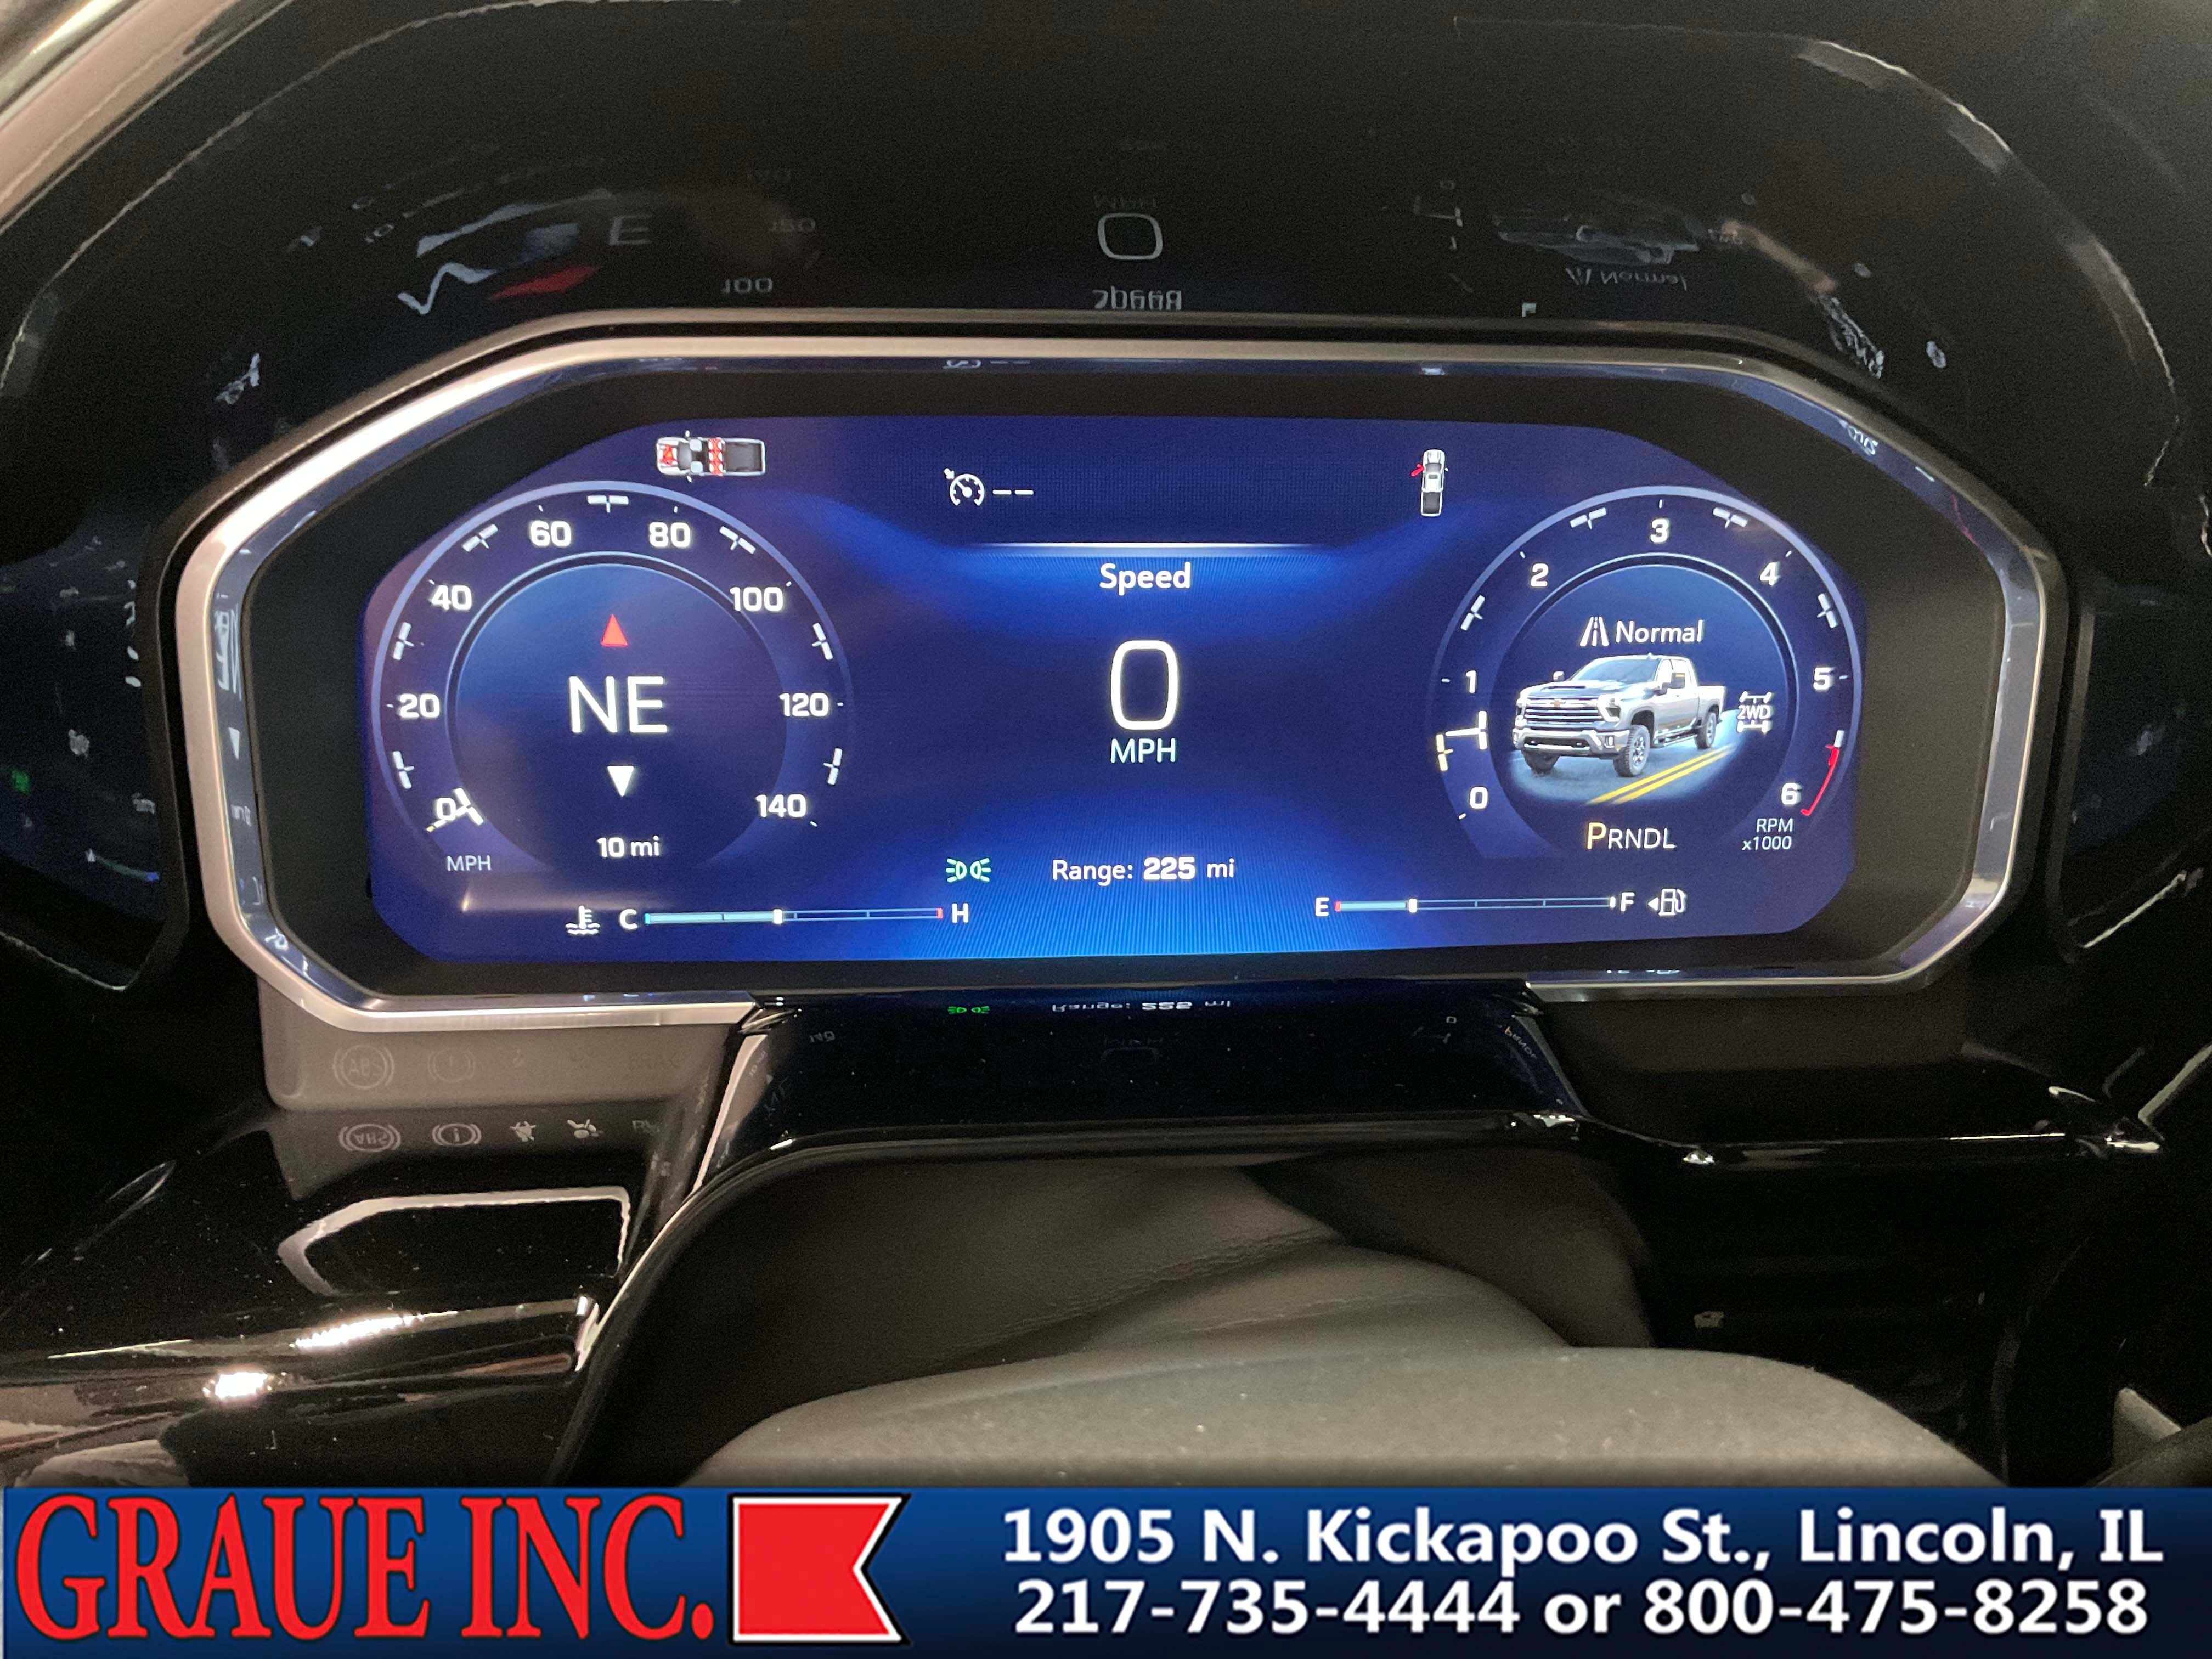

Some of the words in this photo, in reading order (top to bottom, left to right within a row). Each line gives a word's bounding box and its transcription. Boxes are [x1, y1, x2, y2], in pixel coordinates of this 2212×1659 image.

[529, 520, 572, 548] 60
[648, 522, 692, 549] 80
[1650, 518, 1670, 544] 3
[1099, 561, 1191, 596] Speed
[1530, 563, 1549, 588] 2
[1759, 562, 1780, 586] 4
[430, 584, 473, 611] 40
[729, 585, 785, 612] 100
[1616, 619, 1704, 643] Normal
[1110, 640, 1180, 731] 0
[1465, 670, 1476, 693] 1
[1813, 667, 1833, 691] 5
[399, 693, 441, 719] 20
[568, 676, 669, 733] NE
[779, 692, 830, 717] 120
[1737, 704, 1771, 721] 2WD
[1110, 738, 1176, 763] MPH
[755, 794, 807, 818] 140
[1469, 787, 1488, 809] 0
[1781, 782, 1801, 806] 6
[436, 797, 456, 822] 0
[1587, 822, 1676, 850] PRNDL
[1756, 817, 1793, 833] RPM
[597, 837, 626, 858] 10
[630, 835, 660, 857] mi
[1742, 835, 1792, 850] x1000
[447, 855, 492, 871] MPH
[1053, 859, 1133, 887] Range:
[1143, 856, 1196, 881] 225
[1207, 857, 1235, 878] mi
[952, 903, 969, 923] H
[1315, 896, 1330, 917] E
[1620, 891, 1635, 912] F
[619, 909, 638, 930] C
